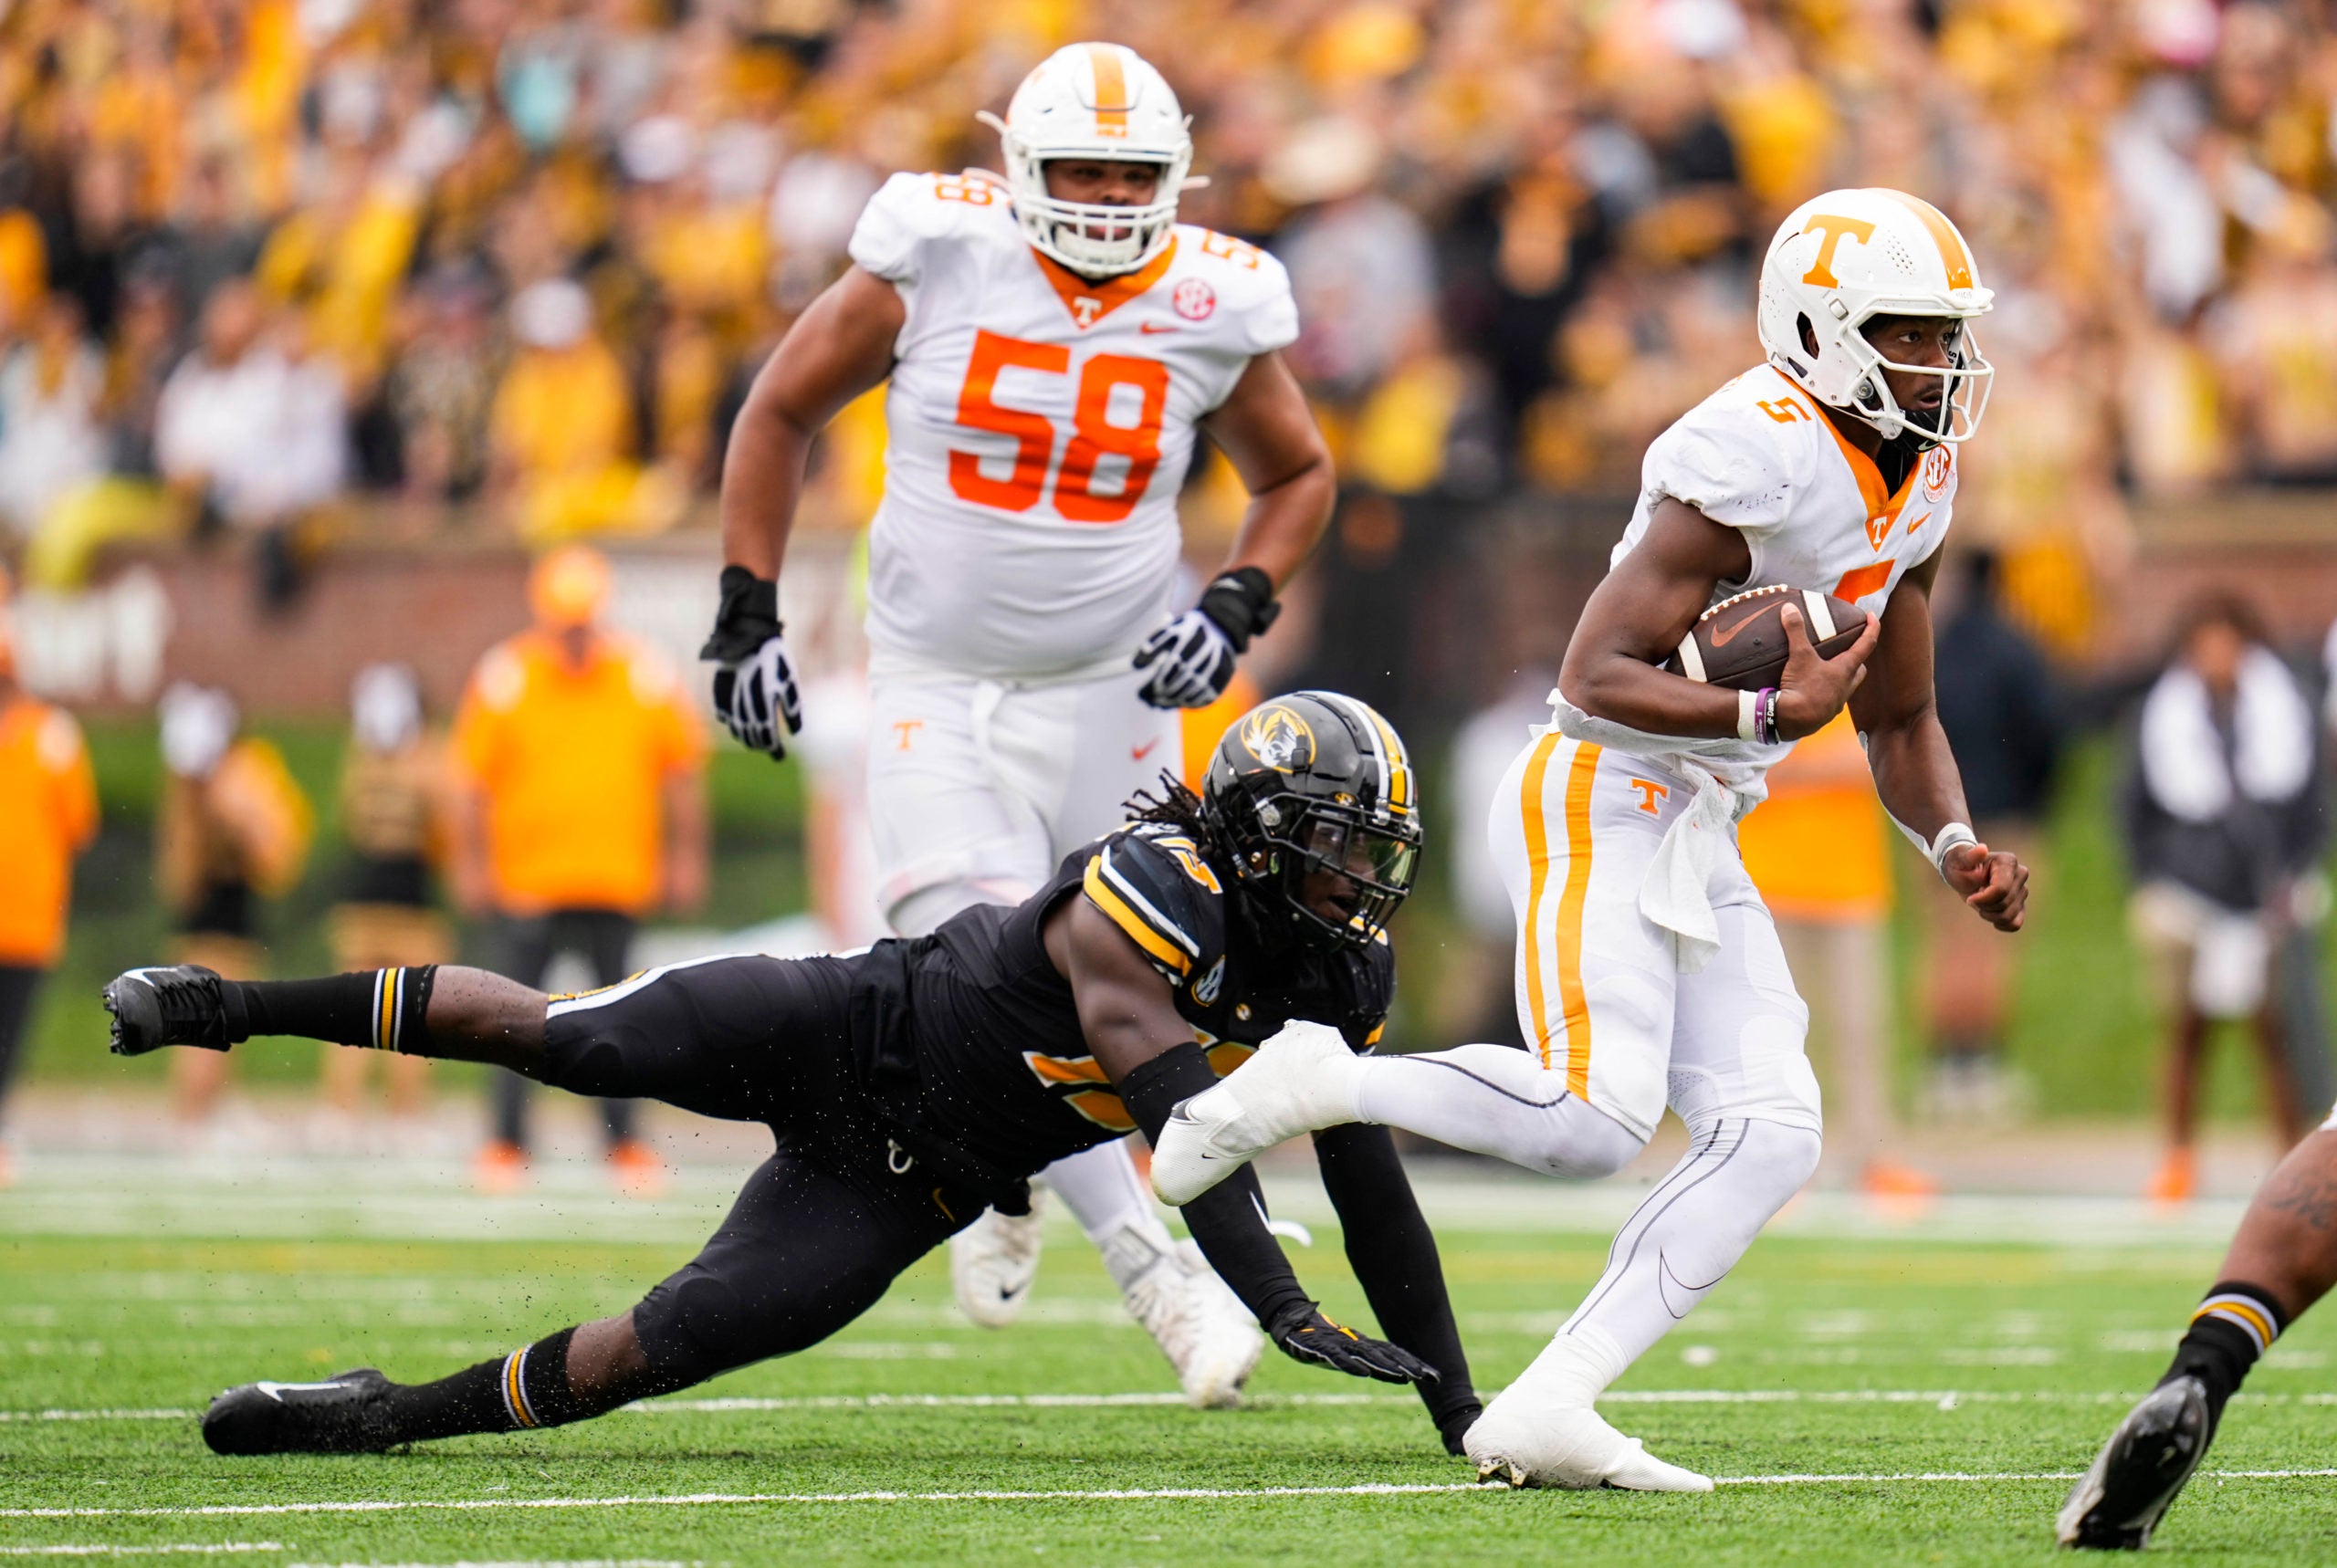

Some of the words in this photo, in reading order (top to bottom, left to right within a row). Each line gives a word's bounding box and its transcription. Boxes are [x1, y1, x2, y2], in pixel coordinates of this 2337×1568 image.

[1801, 214, 1877, 289] T
[1073, 296, 1103, 325] T
[948, 329, 1170, 523] 58
[1755, 396, 1812, 423] 5
[1926, 445, 1949, 487] SEC
[1872, 516, 1888, 544] T
[891, 719, 925, 751] T
[1630, 778, 1669, 817] T
